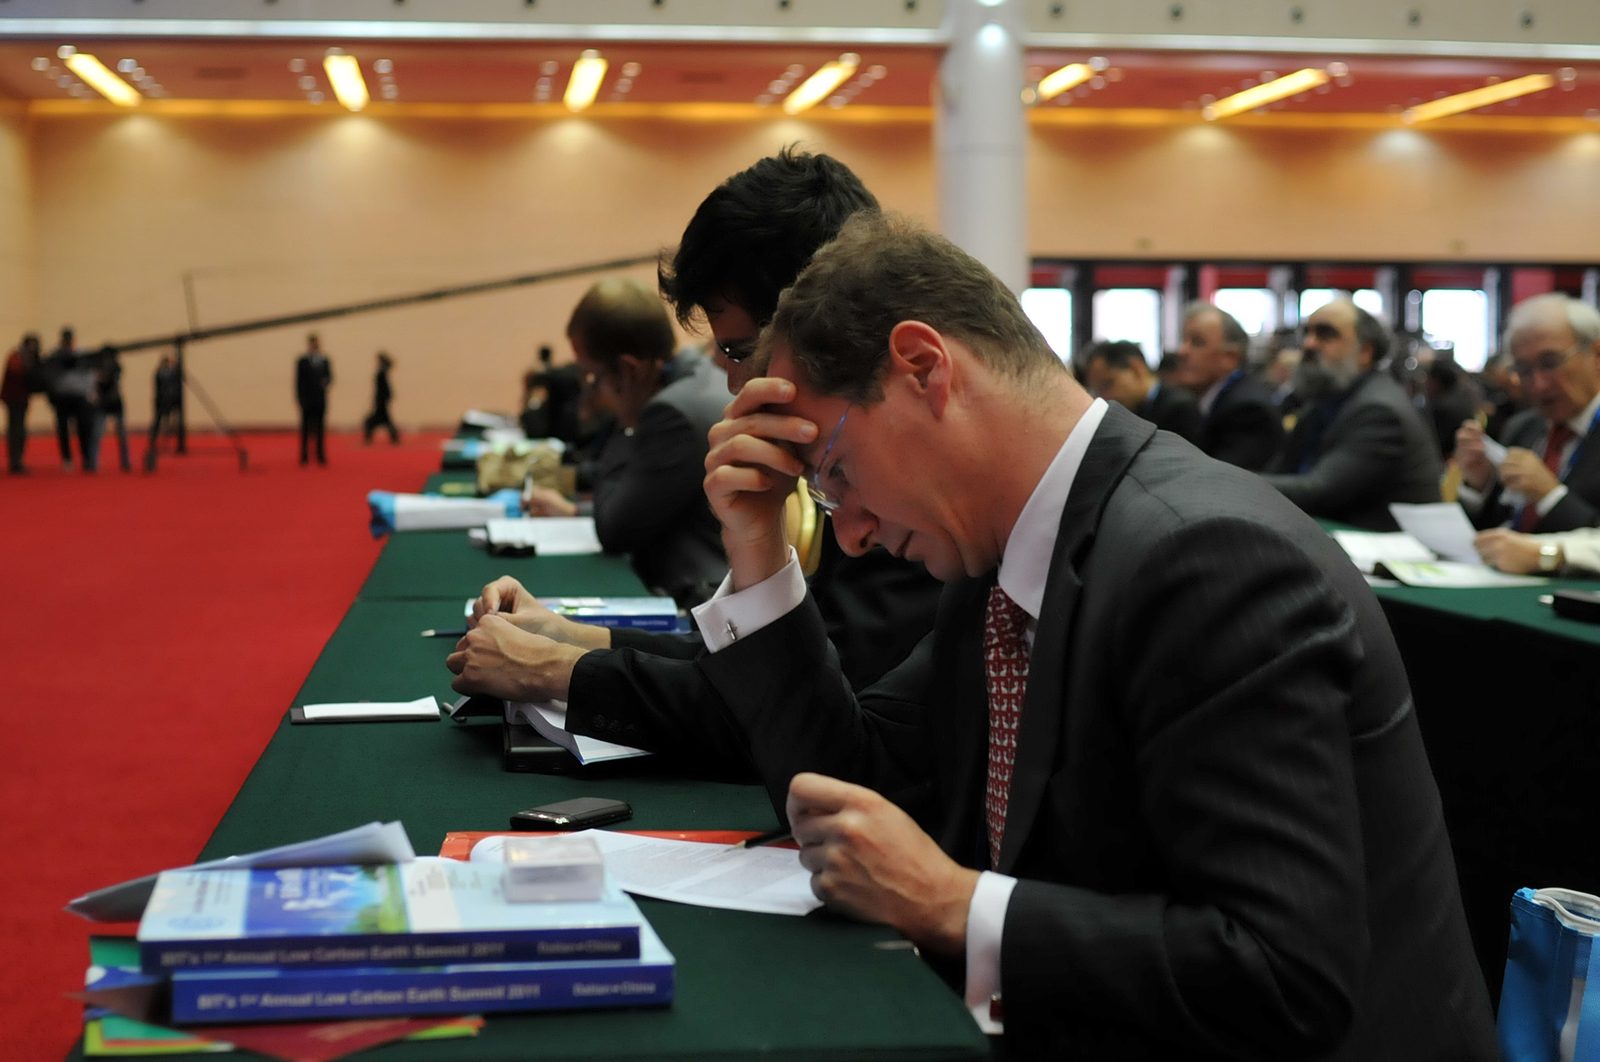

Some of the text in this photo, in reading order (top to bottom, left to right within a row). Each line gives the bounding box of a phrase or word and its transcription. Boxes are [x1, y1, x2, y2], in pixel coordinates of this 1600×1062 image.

[224, 950, 275, 963] Annual
[278, 949, 311, 961] Low
[314, 947, 366, 960] Carbon
[370, 946, 408, 960] Earth
[414, 943, 467, 957] Summit
[472, 942, 505, 956] 2011
[260, 993, 312, 1008] Annual
[315, 991, 347, 1006] Low
[350, 990, 404, 1005] Carbon
[406, 987, 444, 1003] Earth
[450, 985, 505, 1002] Summit
[507, 984, 541, 999] 2011
